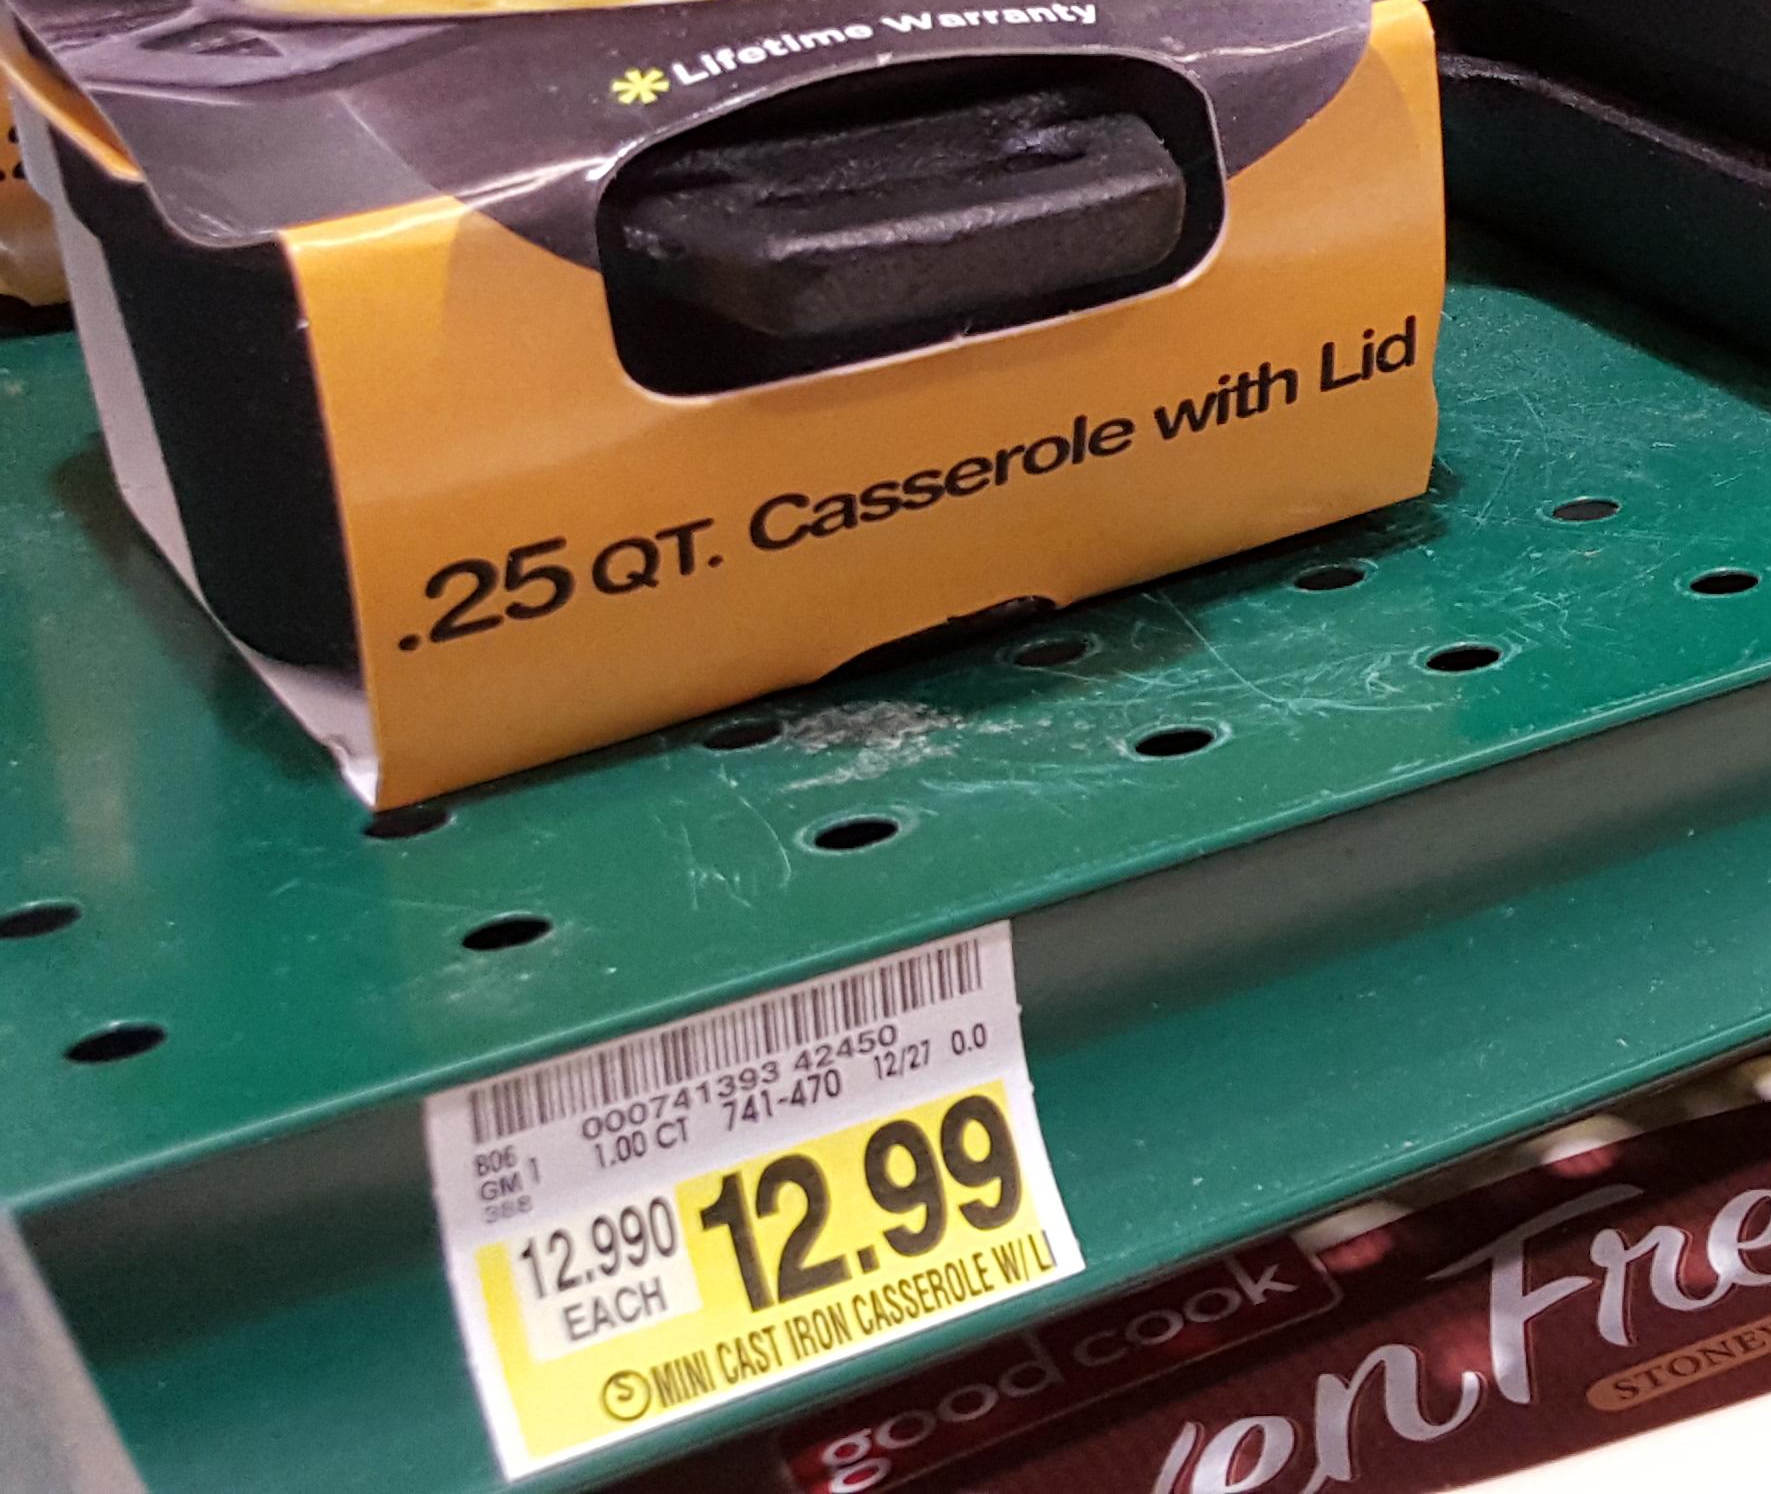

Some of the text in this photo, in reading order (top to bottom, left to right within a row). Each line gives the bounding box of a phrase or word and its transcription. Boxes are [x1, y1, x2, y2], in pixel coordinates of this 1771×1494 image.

[670, 3, 1098, 87] Lifetime Warranty
[397, 316, 1418, 652] .25 QT. Casserole with Lid
[579, 1022, 899, 1140] 000741393 42450
[593, 1133, 650, 1171] 1.00
[656, 1118, 690, 1152] CT
[722, 1070, 842, 1133] 741-470
[873, 1039, 933, 1082] 12/27
[950, 1022, 988, 1056] 0.0
[480, 1172, 523, 1201] GM
[518, 1093, 1025, 1314] 12.990 12.99
[562, 1276, 668, 1344] EACH
[650, 1349, 715, 1409] MINI
[716, 1327, 780, 1384] CAST
[782, 1309, 852, 1368] IRON
[851, 1252, 994, 1338] CASSEROLE
[820, 1254, 1298, 1494] good cook
